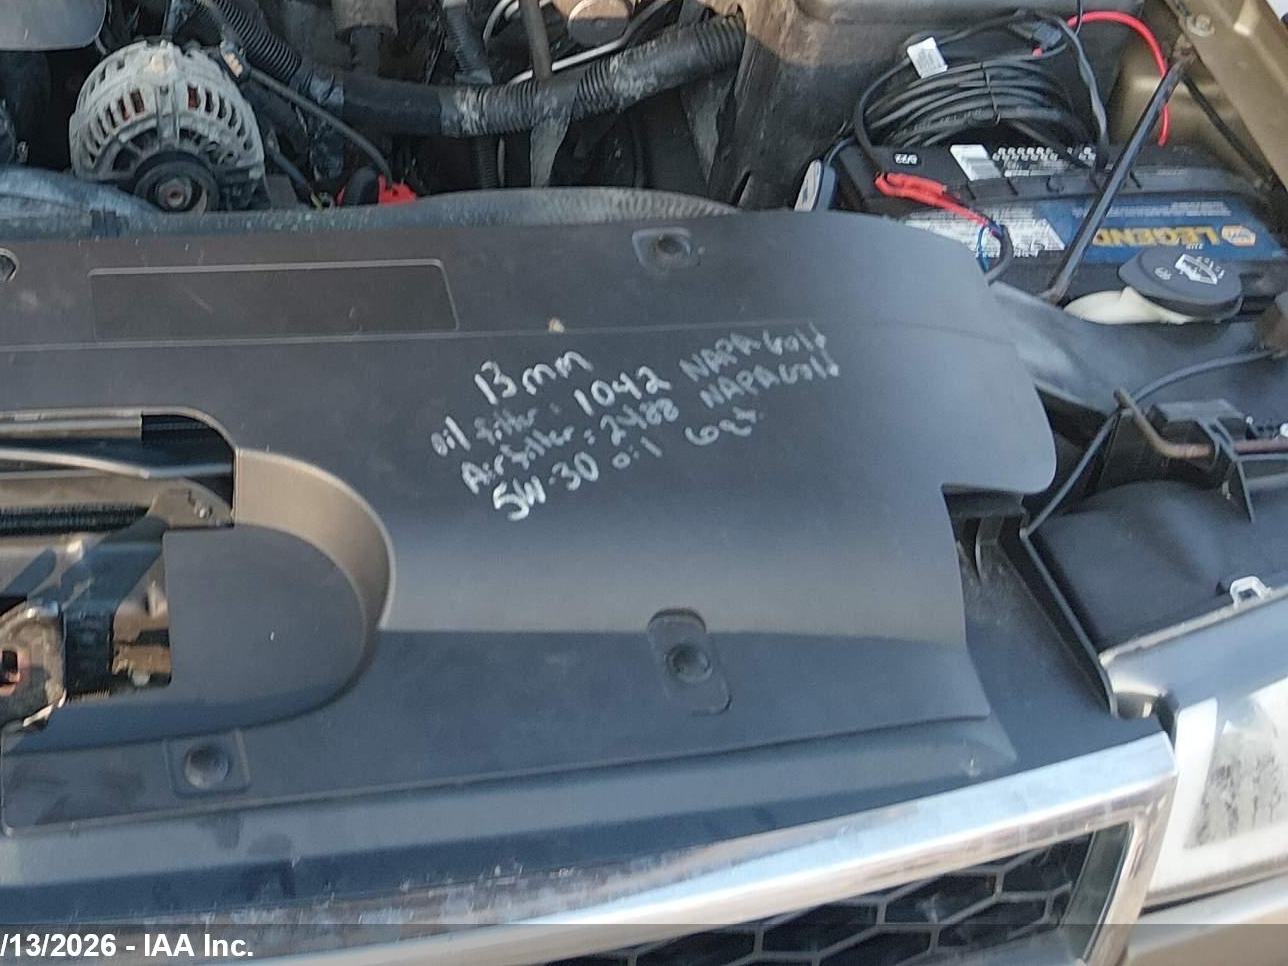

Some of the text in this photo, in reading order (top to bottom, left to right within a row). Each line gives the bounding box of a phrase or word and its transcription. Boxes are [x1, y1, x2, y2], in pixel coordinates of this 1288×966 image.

[1092, 226, 1220, 247] LEGEND
[573, 366, 673, 416] 1042
[679, 333, 762, 383] NAPA
[699, 365, 781, 409] NAPA
